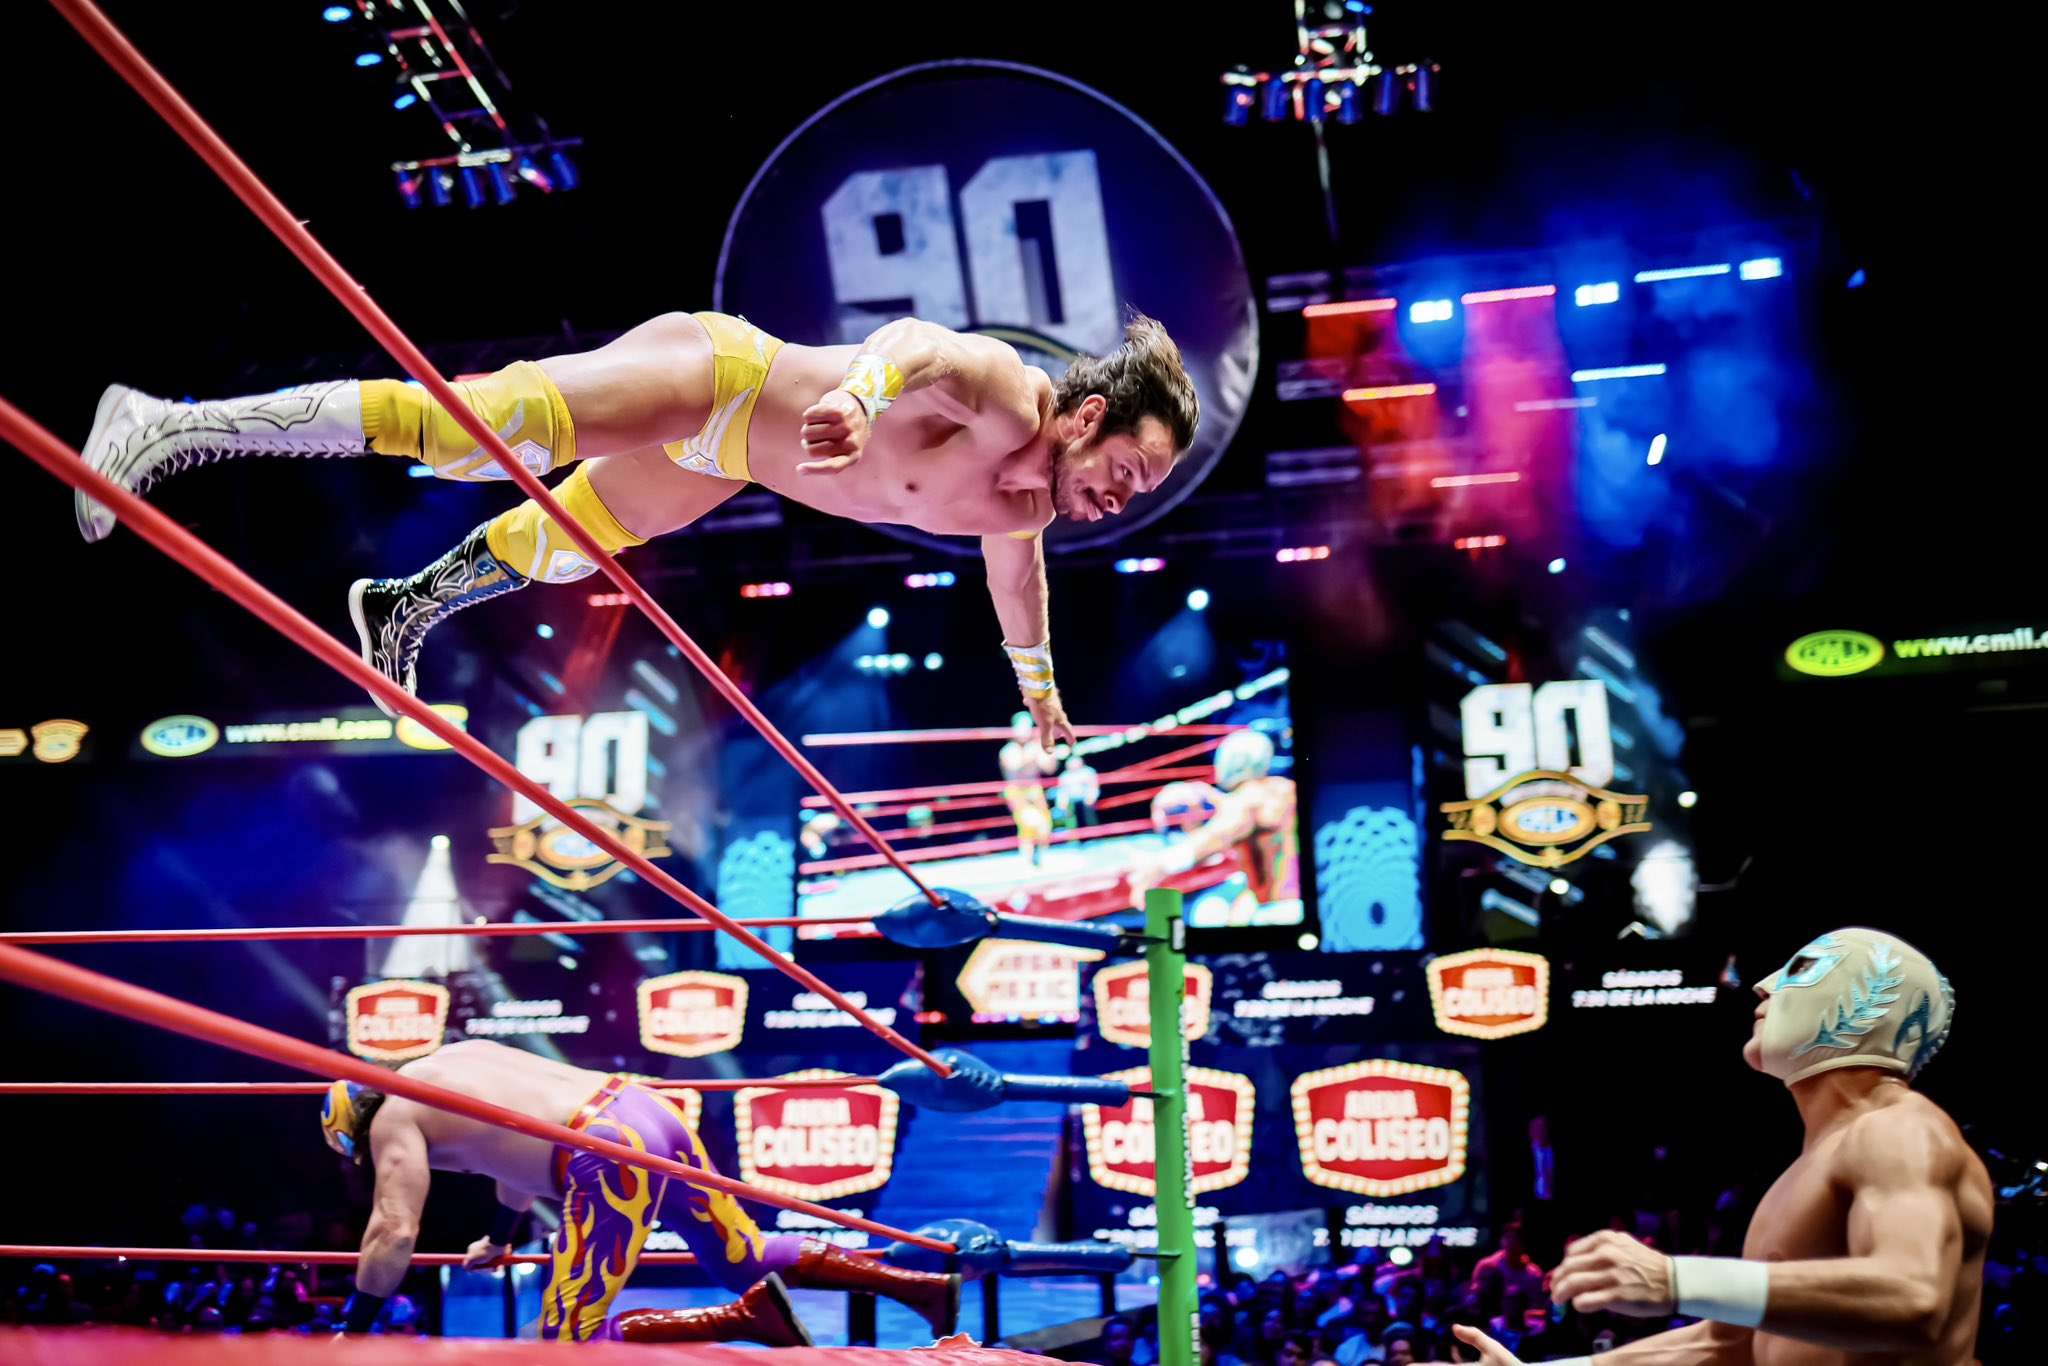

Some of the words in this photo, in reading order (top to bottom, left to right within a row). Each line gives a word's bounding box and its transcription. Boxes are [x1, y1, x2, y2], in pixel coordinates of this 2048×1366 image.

[821, 149, 1119, 360] 90
[512, 711, 650, 826] 90
[1460, 680, 1614, 800] 90
[752, 1124, 879, 1168] COLISEO
[1314, 1117, 1450, 1162] COLISEO
